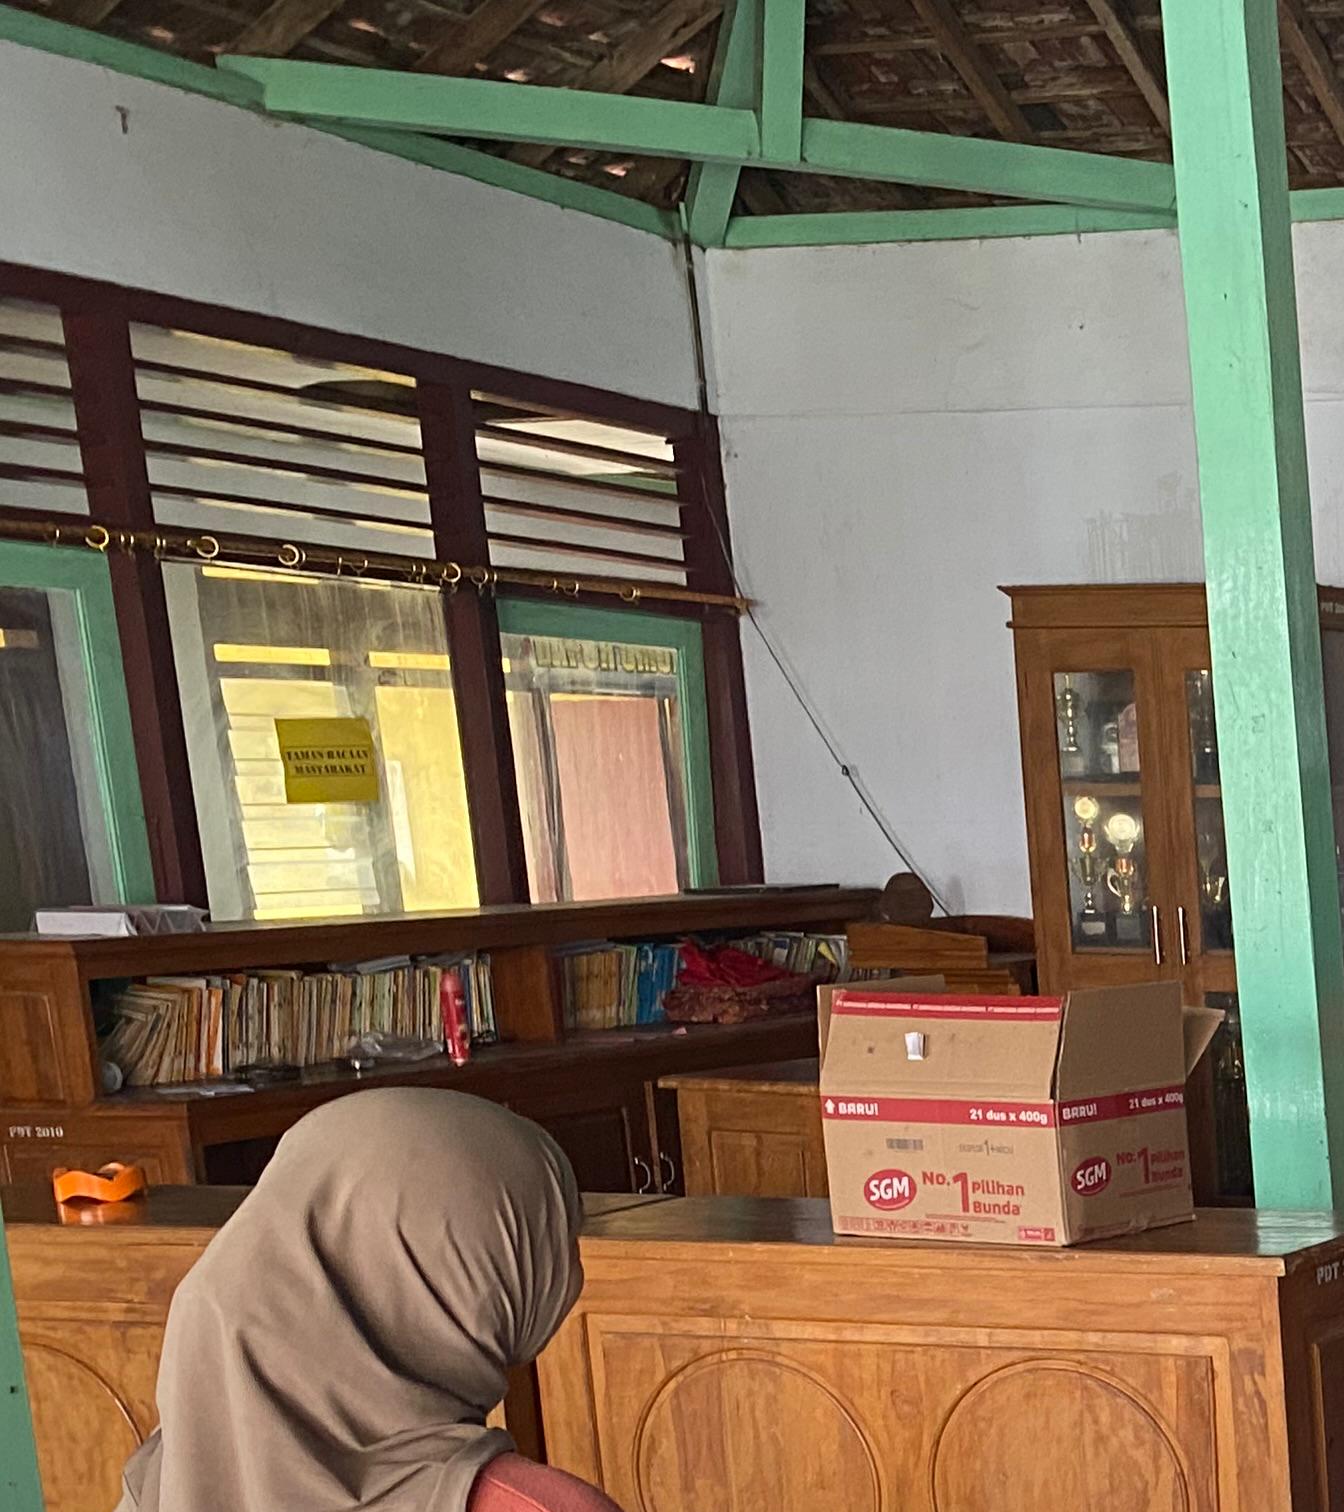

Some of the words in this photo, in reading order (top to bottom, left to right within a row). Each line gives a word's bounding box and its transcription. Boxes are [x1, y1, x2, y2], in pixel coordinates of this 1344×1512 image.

[1129, 1098, 1140, 1109] 21
[969, 1108, 983, 1120] 21
[986, 1109, 1006, 1121] dus
[1009, 1113, 1016, 1121] x
[1019, 1110, 1048, 1124] 400g
[1076, 1162, 1107, 1190] SGM
[869, 1176, 910, 1201] SGM
[973, 1201, 1021, 1216] Bunda
